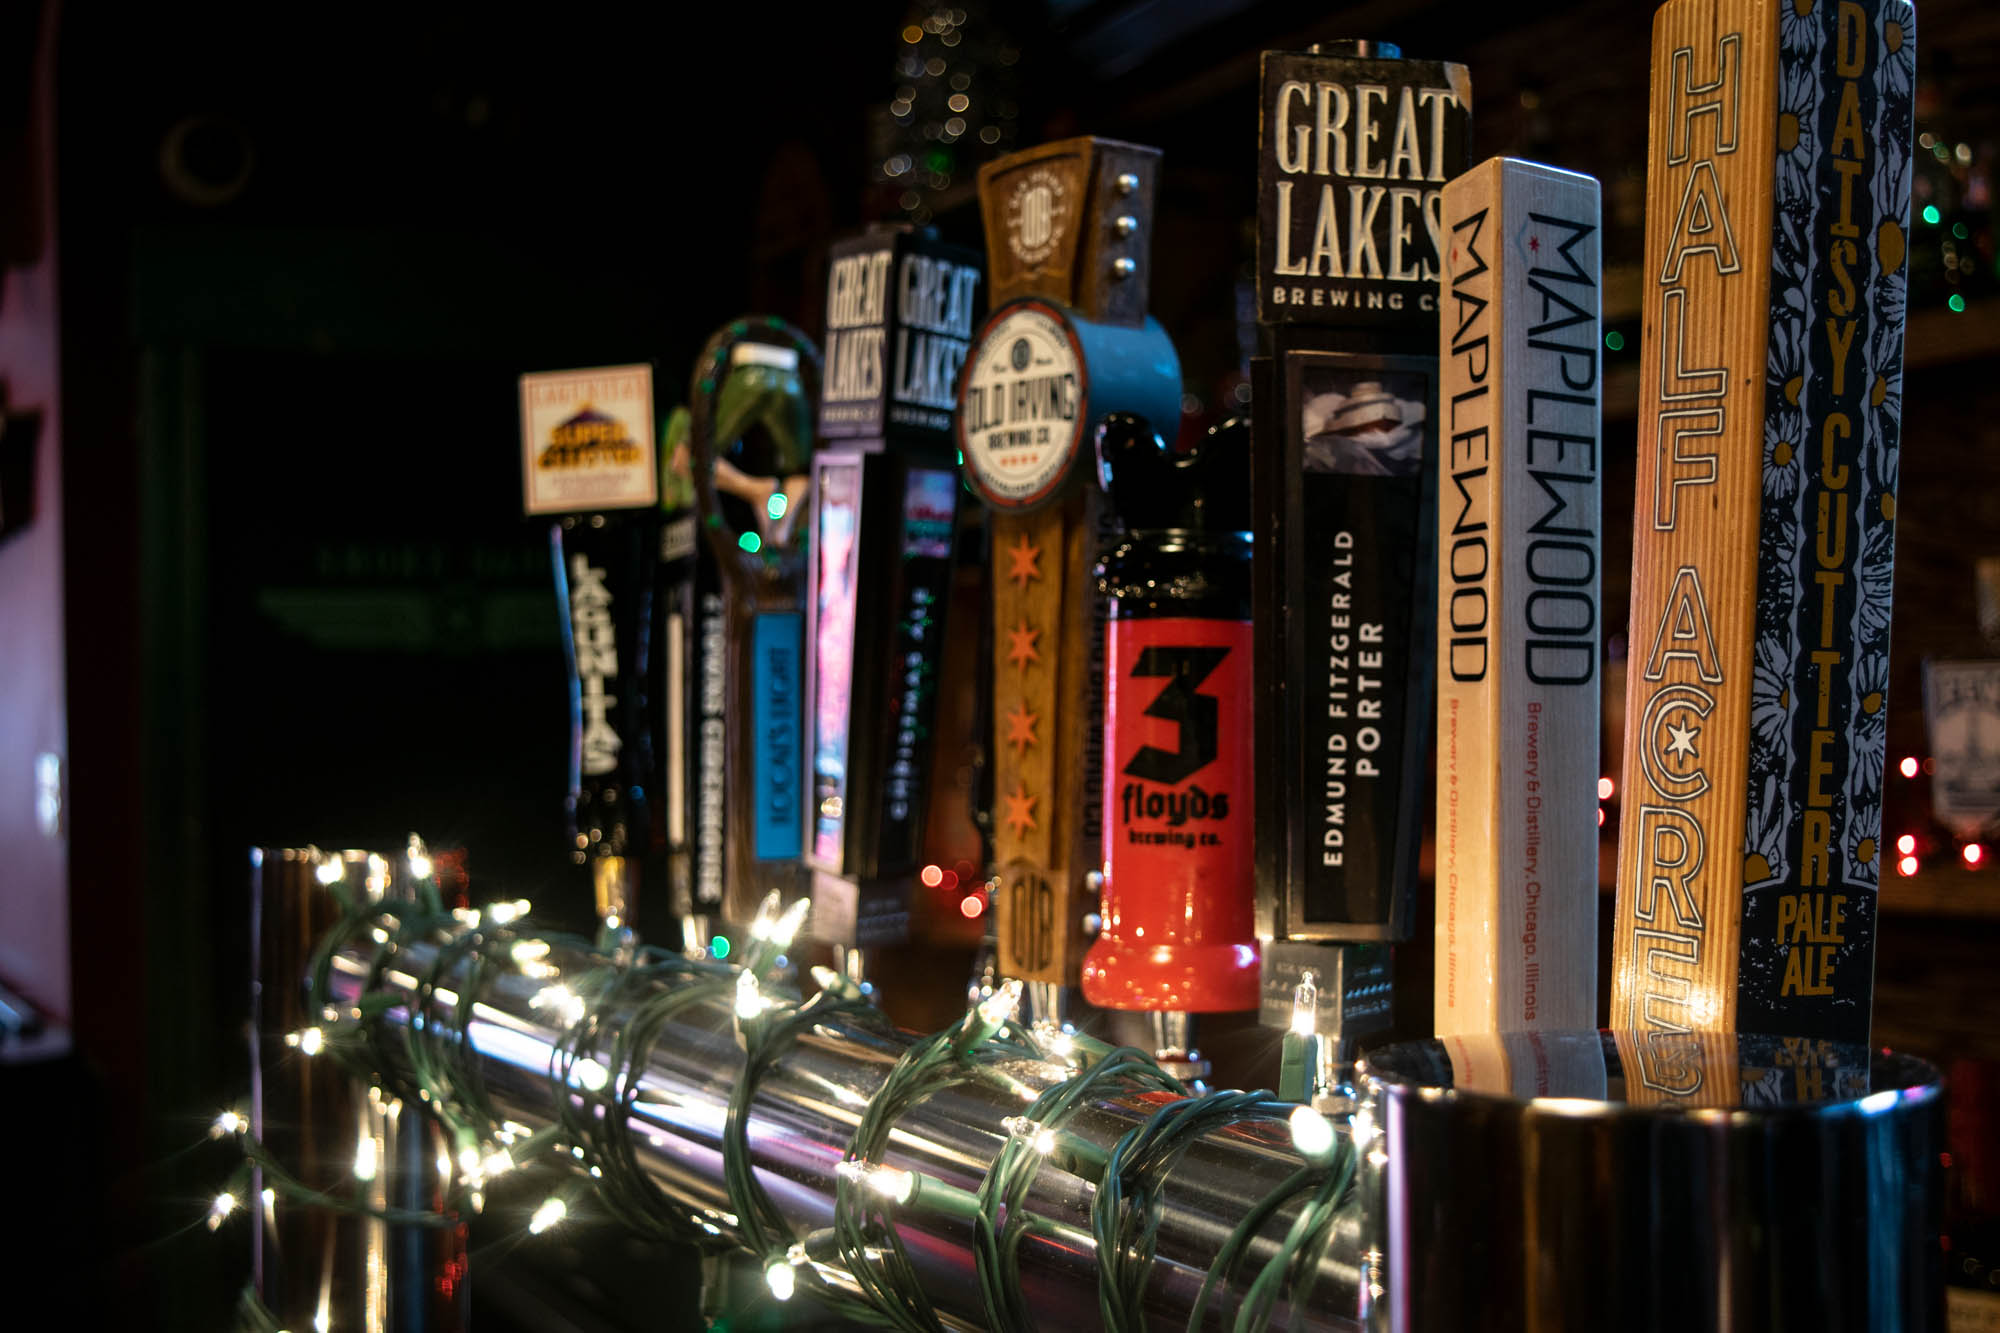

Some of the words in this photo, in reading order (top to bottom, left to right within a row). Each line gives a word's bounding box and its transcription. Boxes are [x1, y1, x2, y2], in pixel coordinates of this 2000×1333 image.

[1275, 80, 1458, 182] GREAT
[1826, 1, 1867, 396] DAISY
[827, 251, 892, 329] GREAT
[899, 254, 980, 337] GREAT
[1273, 286, 1403, 311] BREWING
[1420, 295, 1440, 311] C
[1654, 33, 1741, 531] HALF
[822, 327, 885, 402] LAKES
[893, 328, 968, 411] LAKE
[966, 385, 1004, 434] OLD
[1009, 373, 1075, 422] IRVING
[1450, 207, 1489, 682] MAPLEWOOD
[1525, 212, 1596, 685] MAPLEWOOD
[1328, 531, 1353, 718] FITZGERALD
[1802, 412, 1851, 887] CUTTER
[1123, 646, 1232, 785] 3
[1355, 623, 1383, 776] PORTER
[1524, 702, 1542, 777] Brewery
[1123, 783, 1229, 827] floyds
[1323, 733, 1347, 866] EDMUND
[1527, 781, 1541, 792] &
[1629, 566, 1723, 1032] ACRE
[1129, 829, 1195, 849] brewing
[1777, 895, 1846, 945] PALE
[1524, 963, 1540, 1022] Illinois
[1780, 945, 1837, 997] ALE
